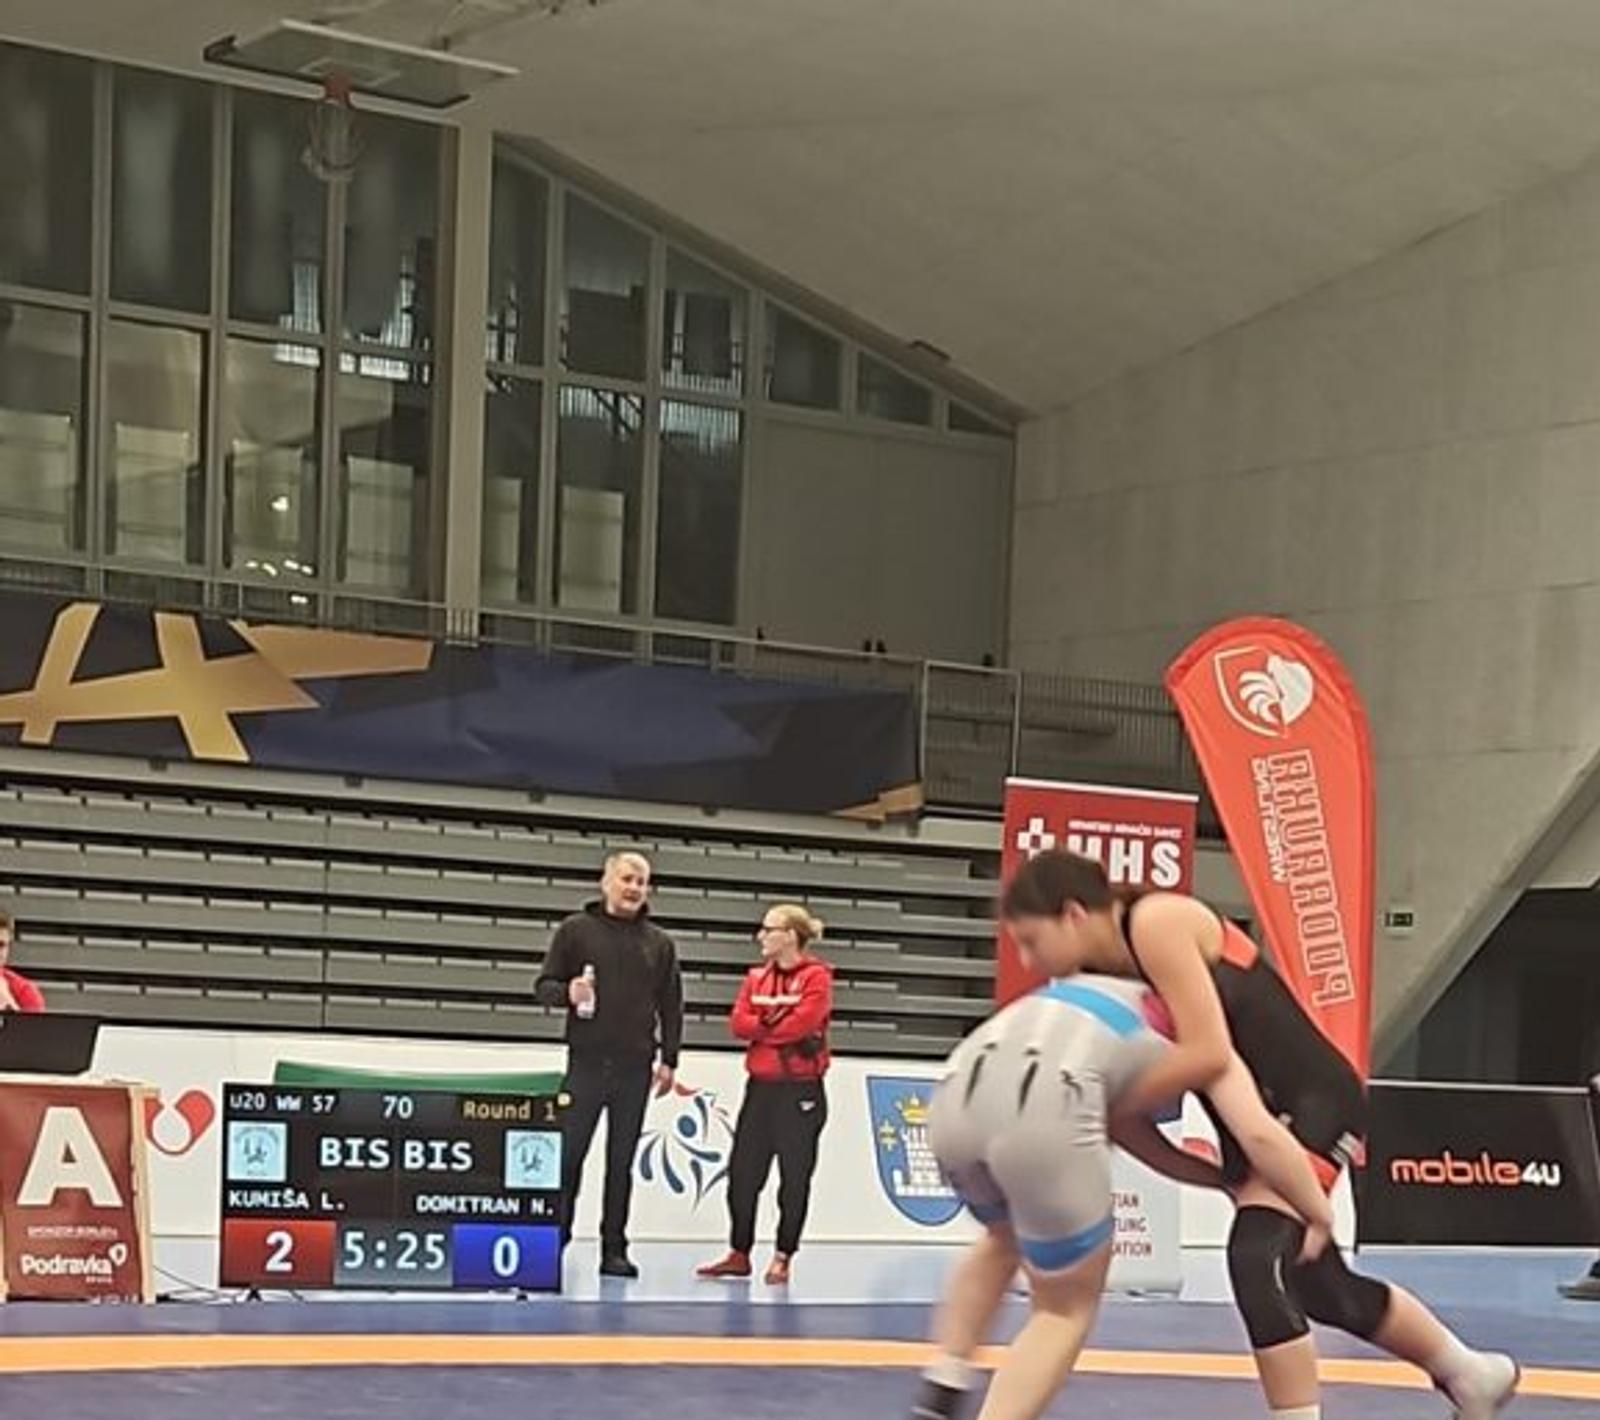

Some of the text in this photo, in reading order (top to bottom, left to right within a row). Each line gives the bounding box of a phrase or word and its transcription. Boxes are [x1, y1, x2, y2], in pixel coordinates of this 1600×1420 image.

[229, 1092, 266, 1110] U20
[312, 1095, 336, 1113] 57
[382, 1095, 413, 1119] 70
[462, 1100, 532, 1120] Round
[544, 1101, 556, 1121] 1
[16, 1106, 124, 1208] A
[320, 1136, 391, 1170] BIS
[403, 1139, 473, 1171] BIS
[228, 1188, 346, 1211] KUMIŠA L.
[416, 1194, 555, 1216] DOMITRAN N.
[265, 1230, 294, 1272] 2
[343, 1230, 446, 1271] 5:25
[493, 1235, 520, 1278] 0
